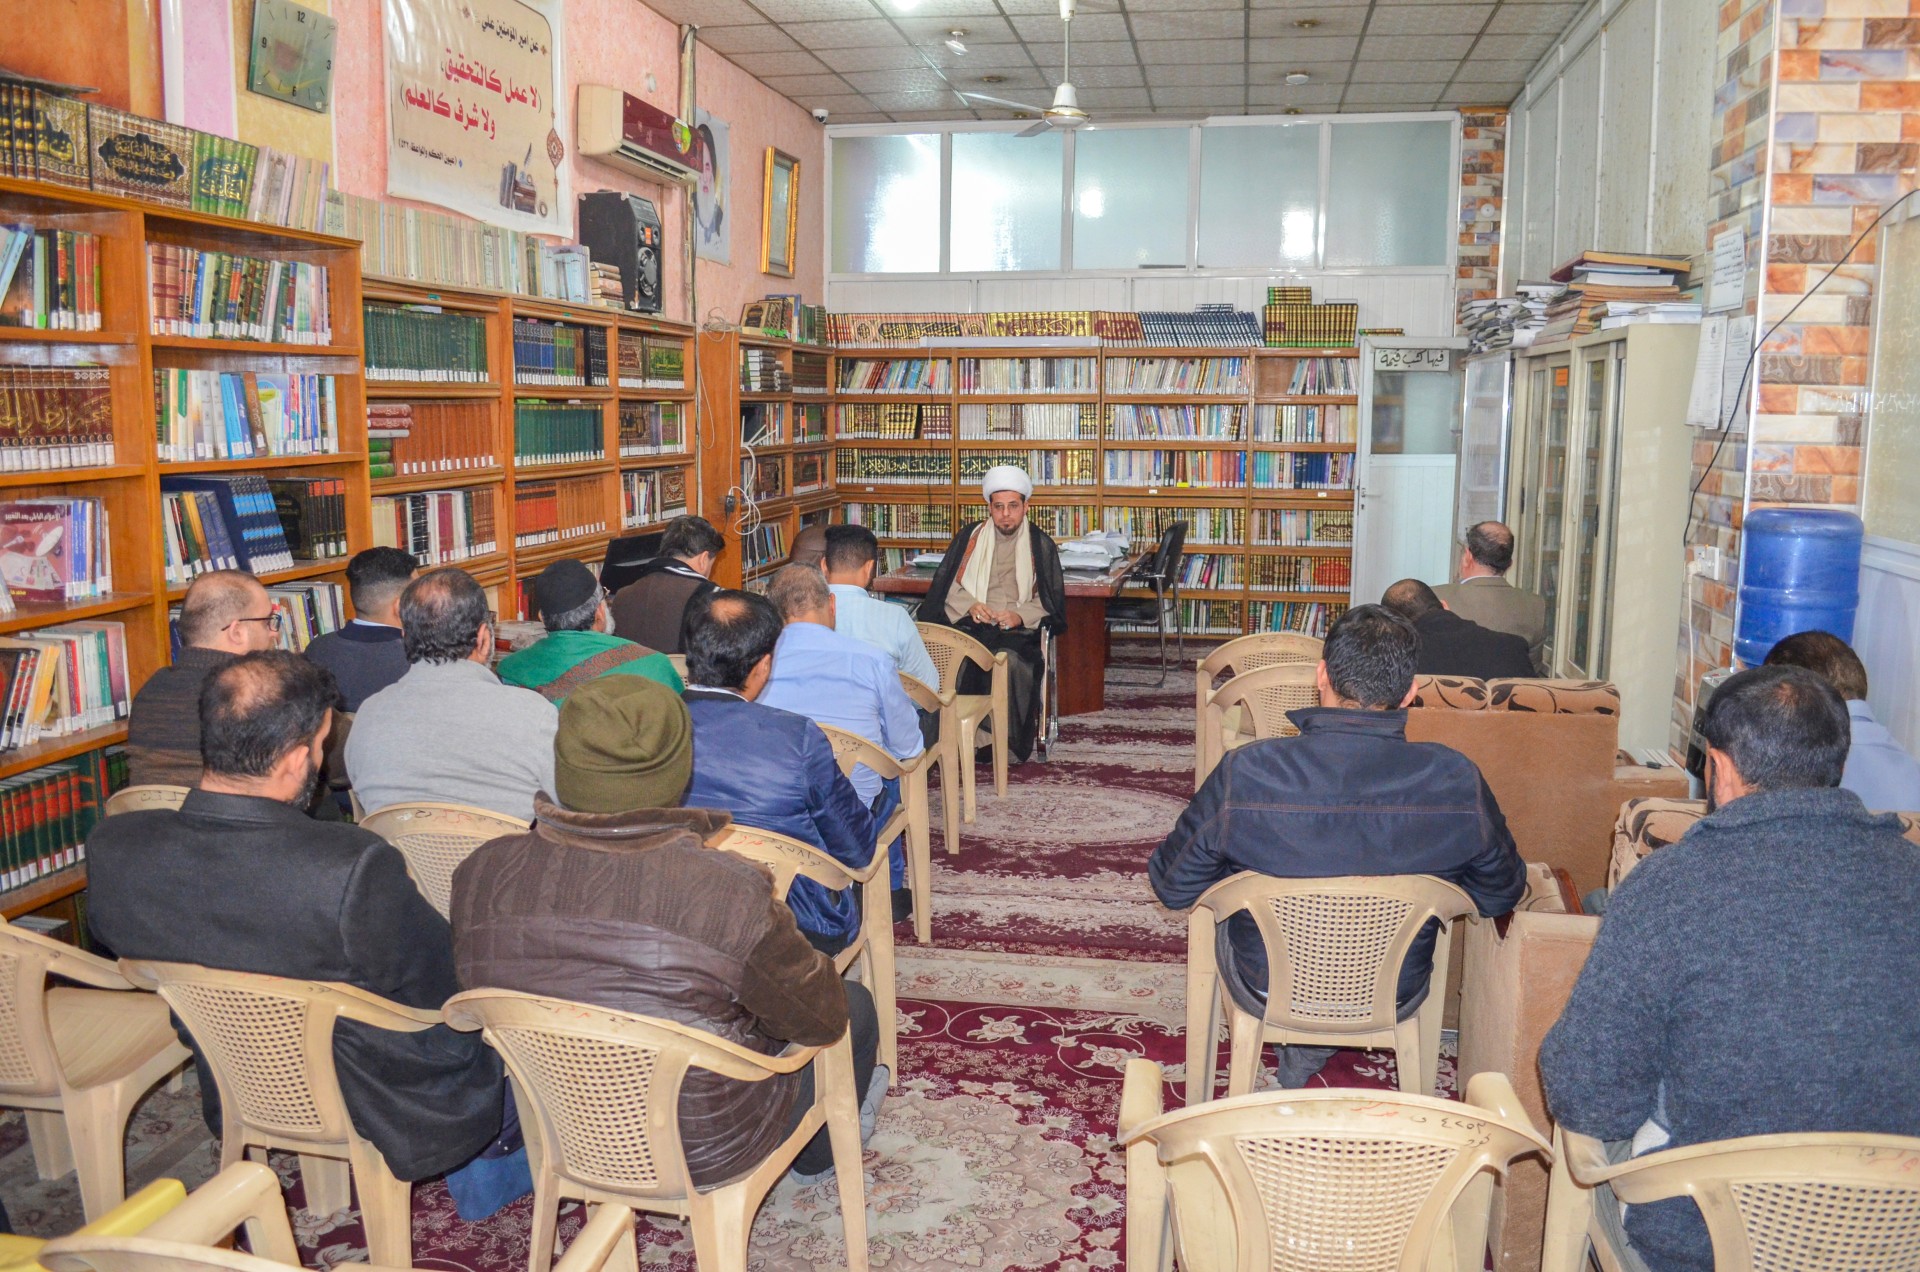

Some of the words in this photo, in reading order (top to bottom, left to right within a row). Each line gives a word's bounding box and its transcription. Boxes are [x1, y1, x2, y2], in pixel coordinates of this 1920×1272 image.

[297, 11, 306, 24] 12
[261, 36, 268, 49] 9
[529, 37, 539, 54] عن
[326, 59, 332, 71] 3
[291, 85, 297, 98] 6
[504, 76, 528, 104] عمل
[453, 96, 479, 132] شرف
[481, 106, 496, 141] ولا
[1402, 348, 1428, 368] كتب
[1426, 348, 1445, 368] فيها
